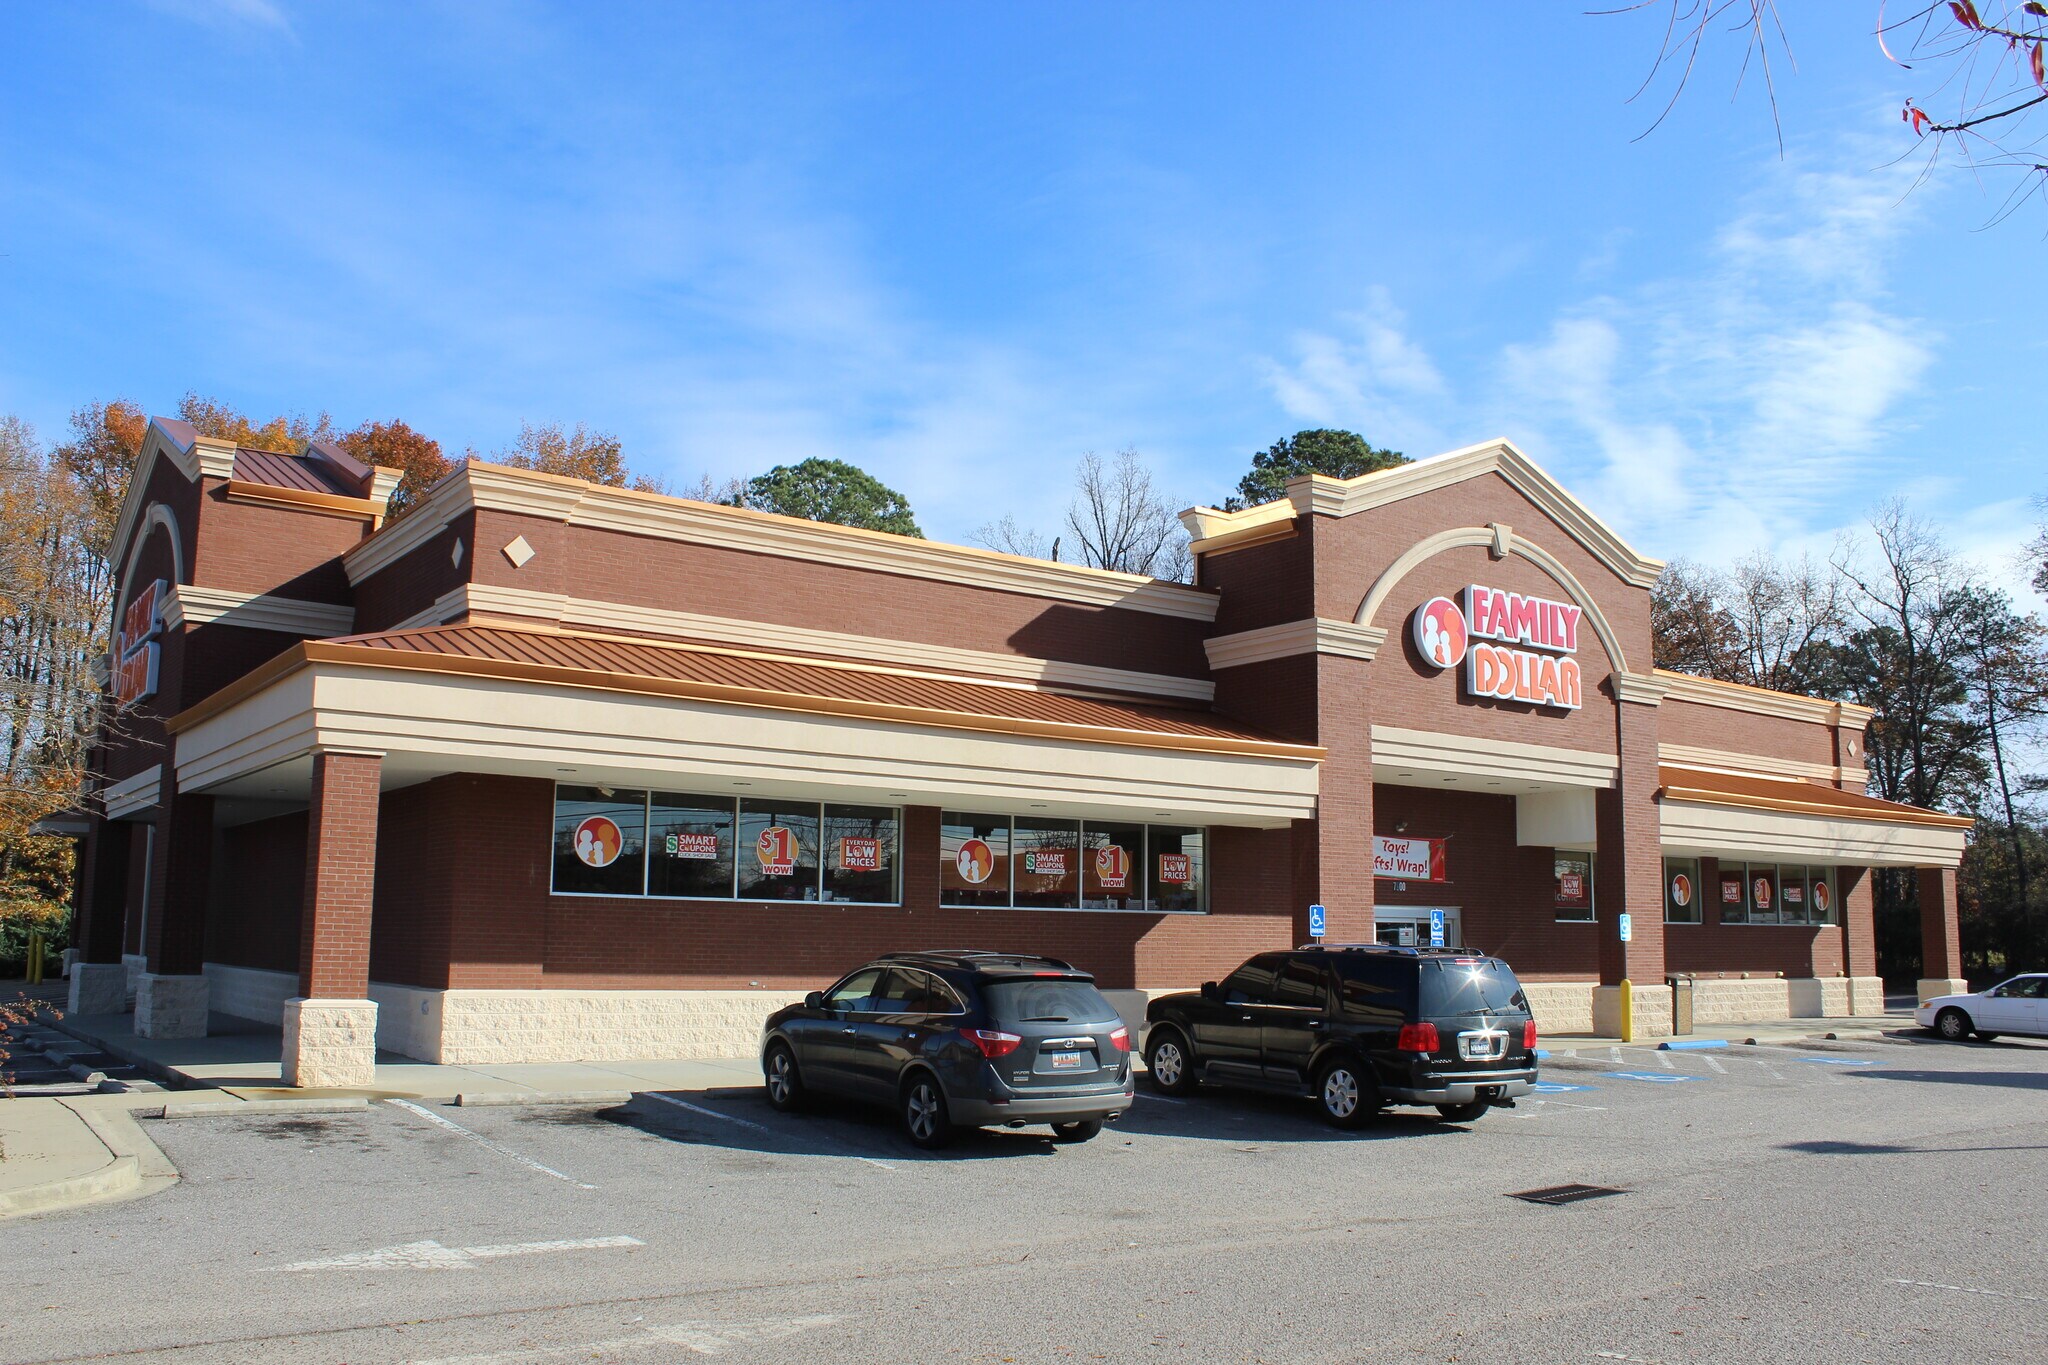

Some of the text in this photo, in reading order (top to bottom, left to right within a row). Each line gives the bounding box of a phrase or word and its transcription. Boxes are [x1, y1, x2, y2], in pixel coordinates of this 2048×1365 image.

[1472, 587, 1580, 650] FAMILY
[1474, 646, 1581, 706] DOLLAR
[679, 834, 716, 845] SMART
[761, 828, 792, 865] $1
[846, 846, 875, 857] LOW
[1382, 840, 1410, 857] Toys!
[846, 858, 876, 867] PRICES
[1036, 853, 1065, 862] SMART
[1099, 846, 1124, 878] $1
[764, 866, 793, 874] WOW!
[1164, 861, 1186, 871] LOW
[1373, 855, 1428, 877] fts! Wrap!
[1164, 872, 1187, 880] PRICES
